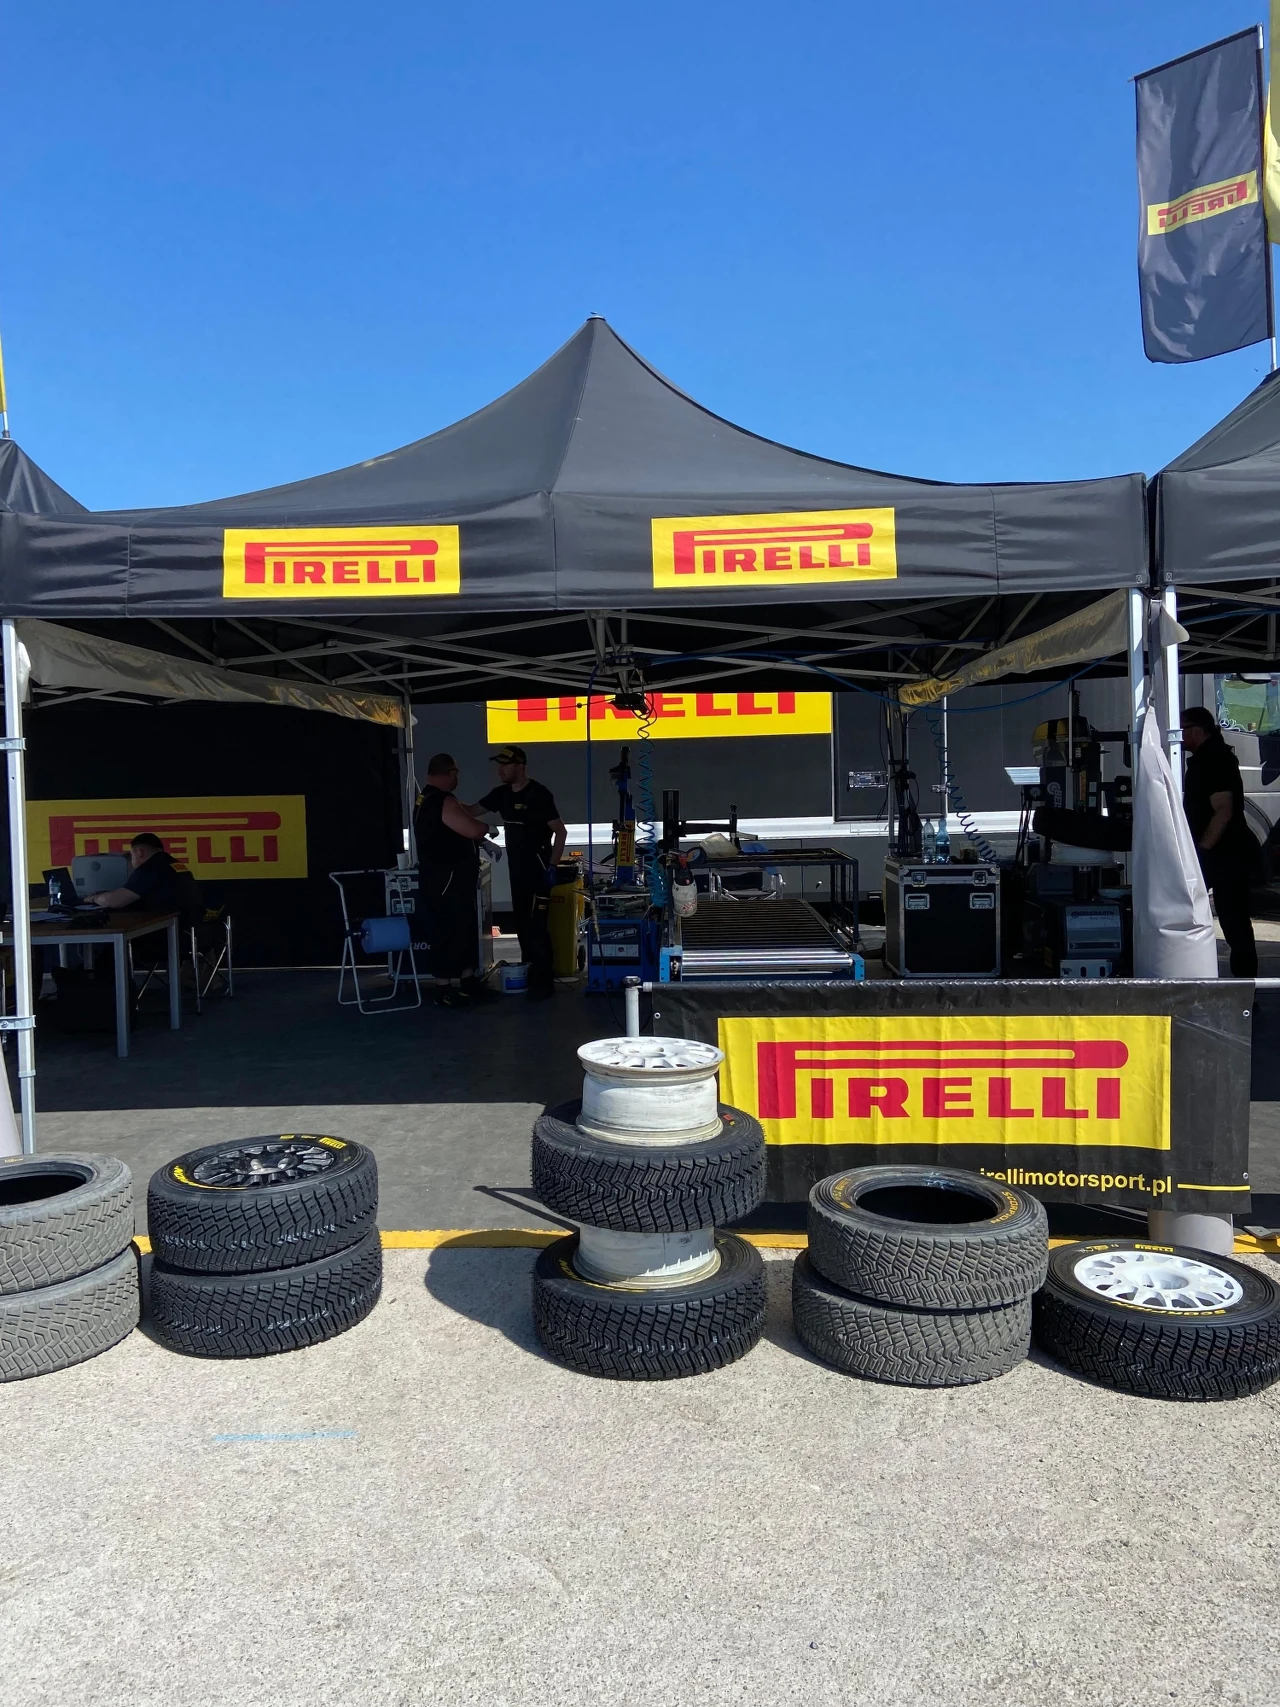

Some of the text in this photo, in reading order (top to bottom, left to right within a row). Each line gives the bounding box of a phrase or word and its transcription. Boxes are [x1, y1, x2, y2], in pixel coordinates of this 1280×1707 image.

[244, 539, 439, 584] PIRELLI
[673, 522, 874, 575] PIRELLI
[757, 1040, 1129, 1119] PIRELLI
